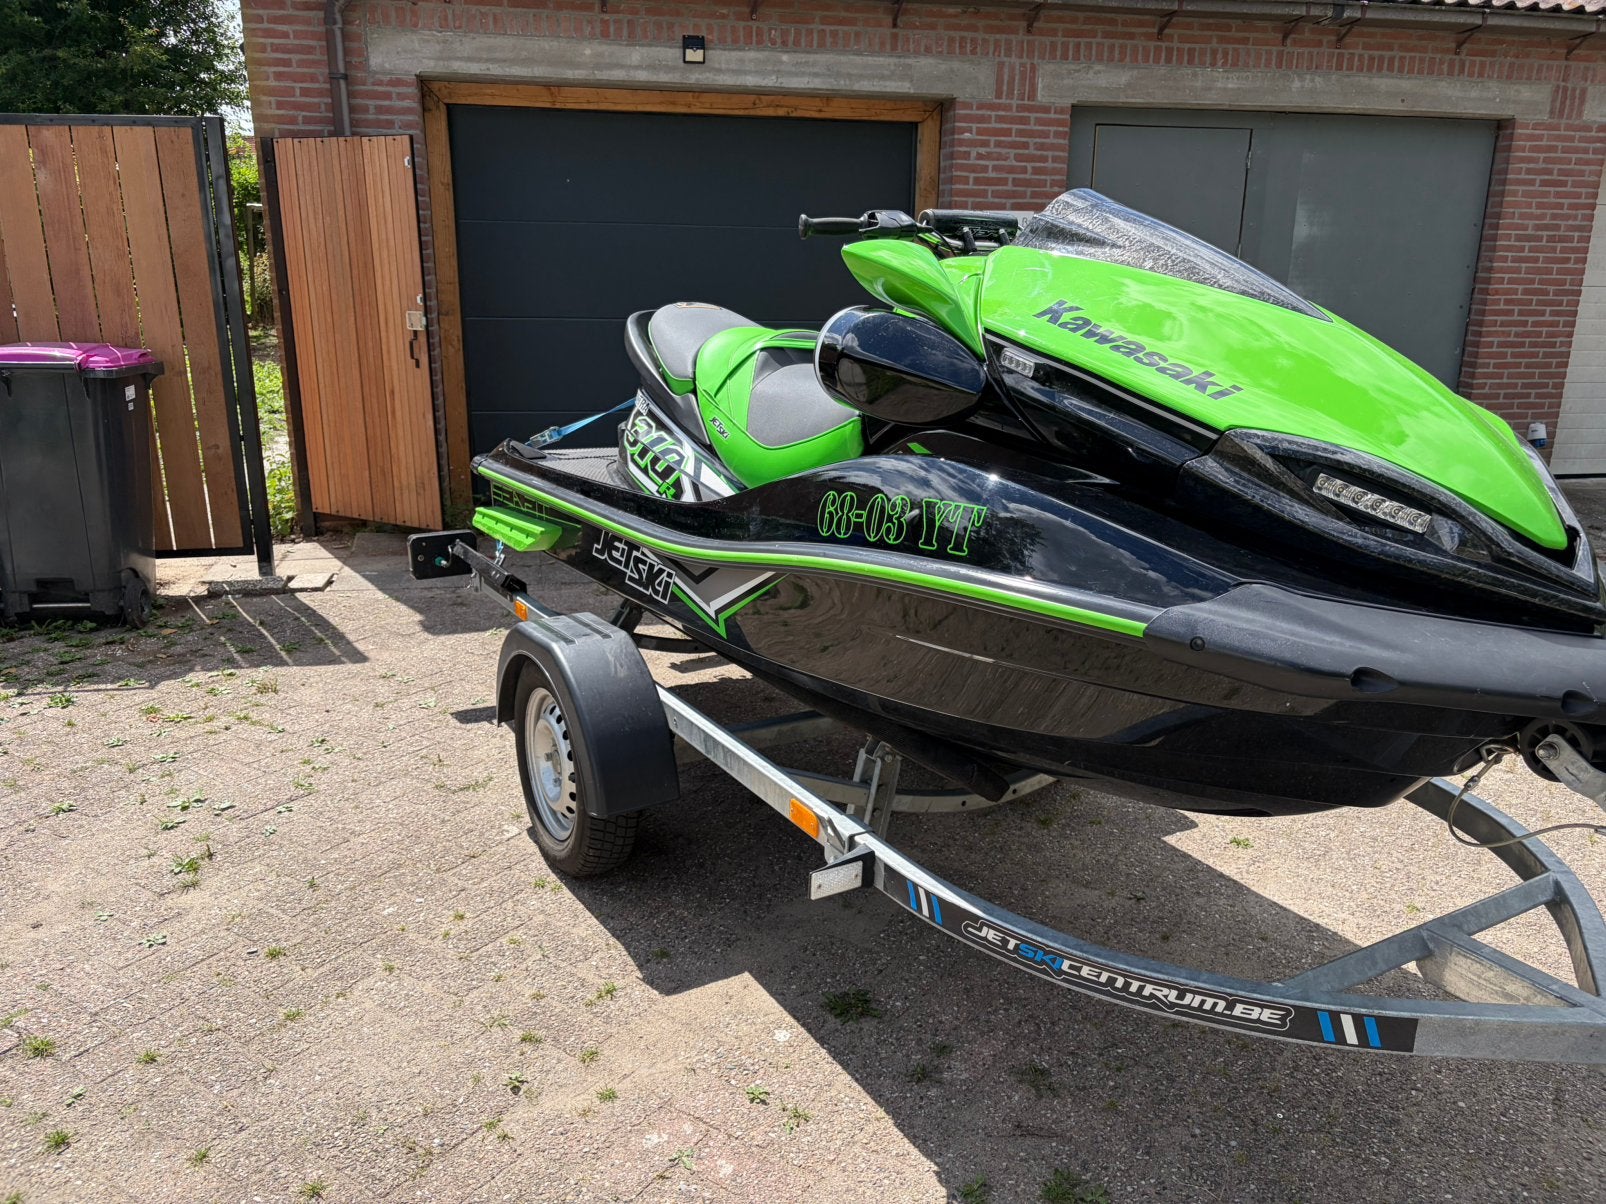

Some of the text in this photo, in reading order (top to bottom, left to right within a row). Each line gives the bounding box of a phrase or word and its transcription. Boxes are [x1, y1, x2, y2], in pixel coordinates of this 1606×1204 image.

[1032, 299, 1244, 400] Kawasaki
[817, 490, 988, 556] 68-03 YT
[967, 926, 1287, 1025] JETSKICENTRUM.BE
